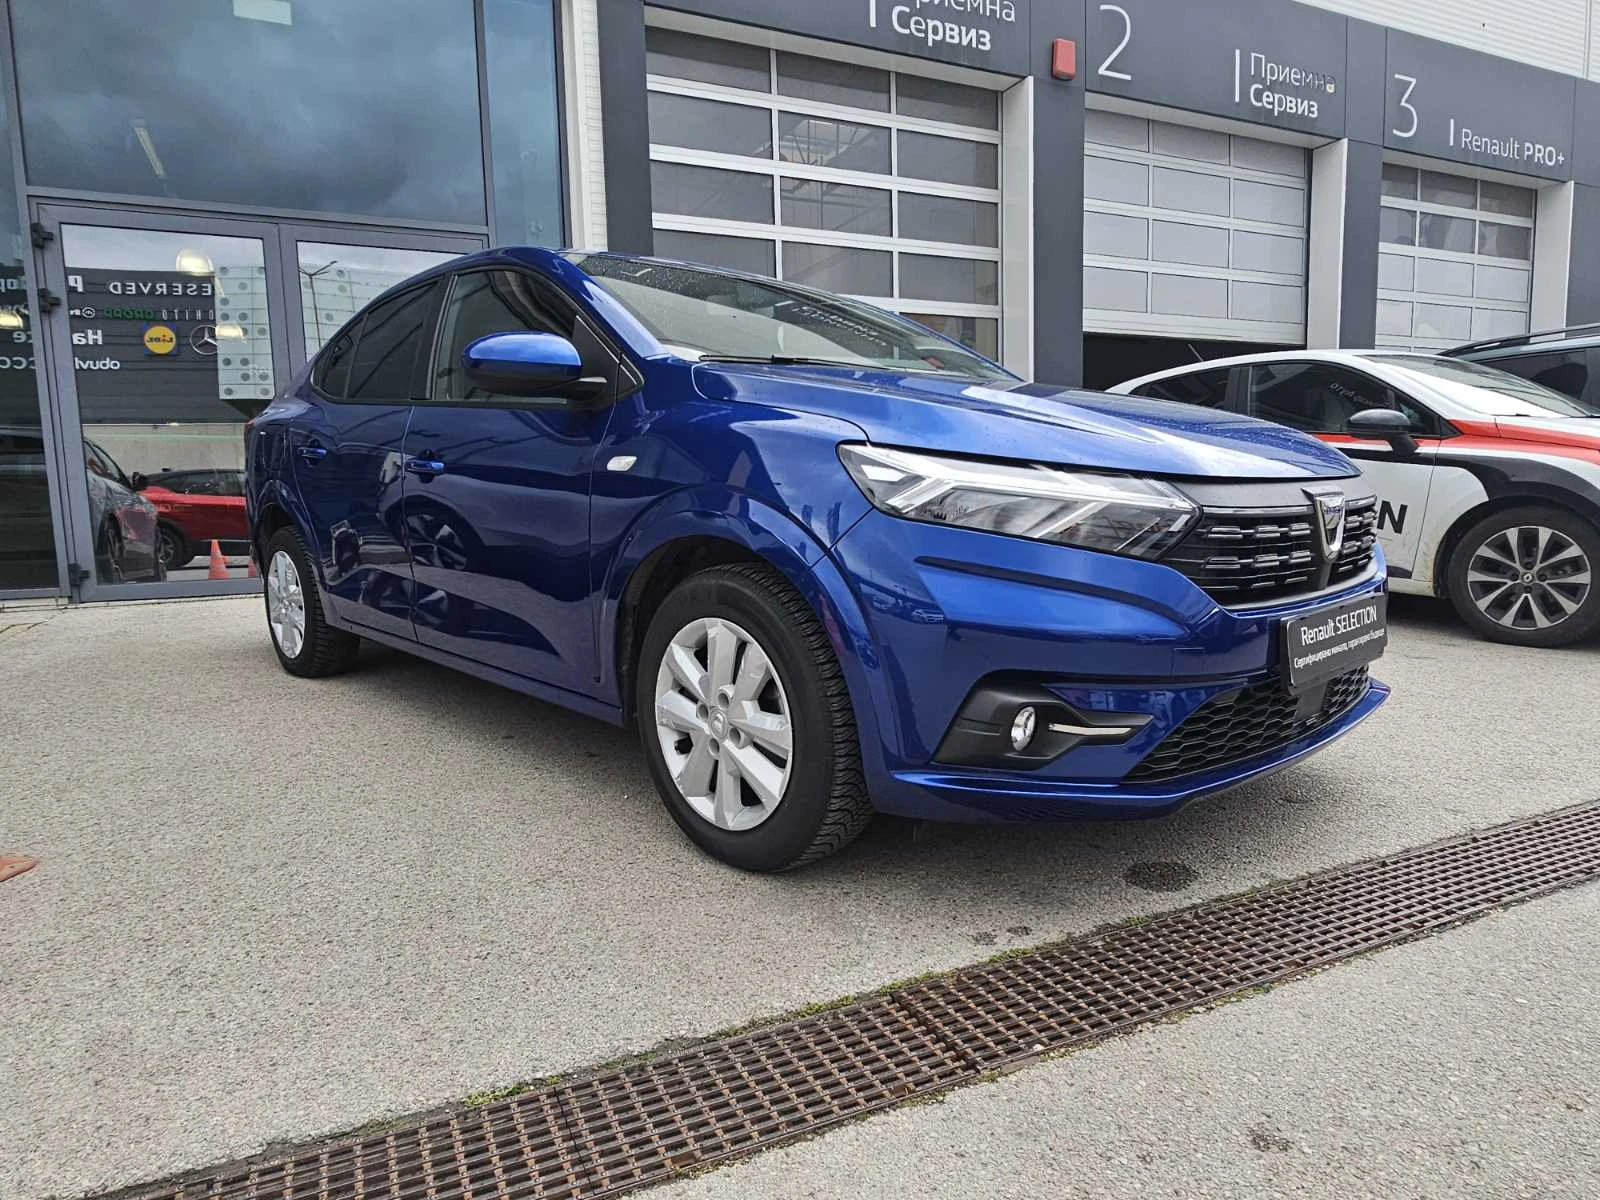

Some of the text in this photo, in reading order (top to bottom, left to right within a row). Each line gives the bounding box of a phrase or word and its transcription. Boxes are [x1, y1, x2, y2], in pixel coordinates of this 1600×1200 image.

[891, 5, 992, 51] Сервиз
[1098, 4, 1132, 80] 2
[1250, 83, 1318, 118] Сервиз
[1392, 73, 1418, 138] 3
[1461, 128, 1565, 166] Renault PRO+
[1300, 605, 1378, 646] Renault SELECTION
